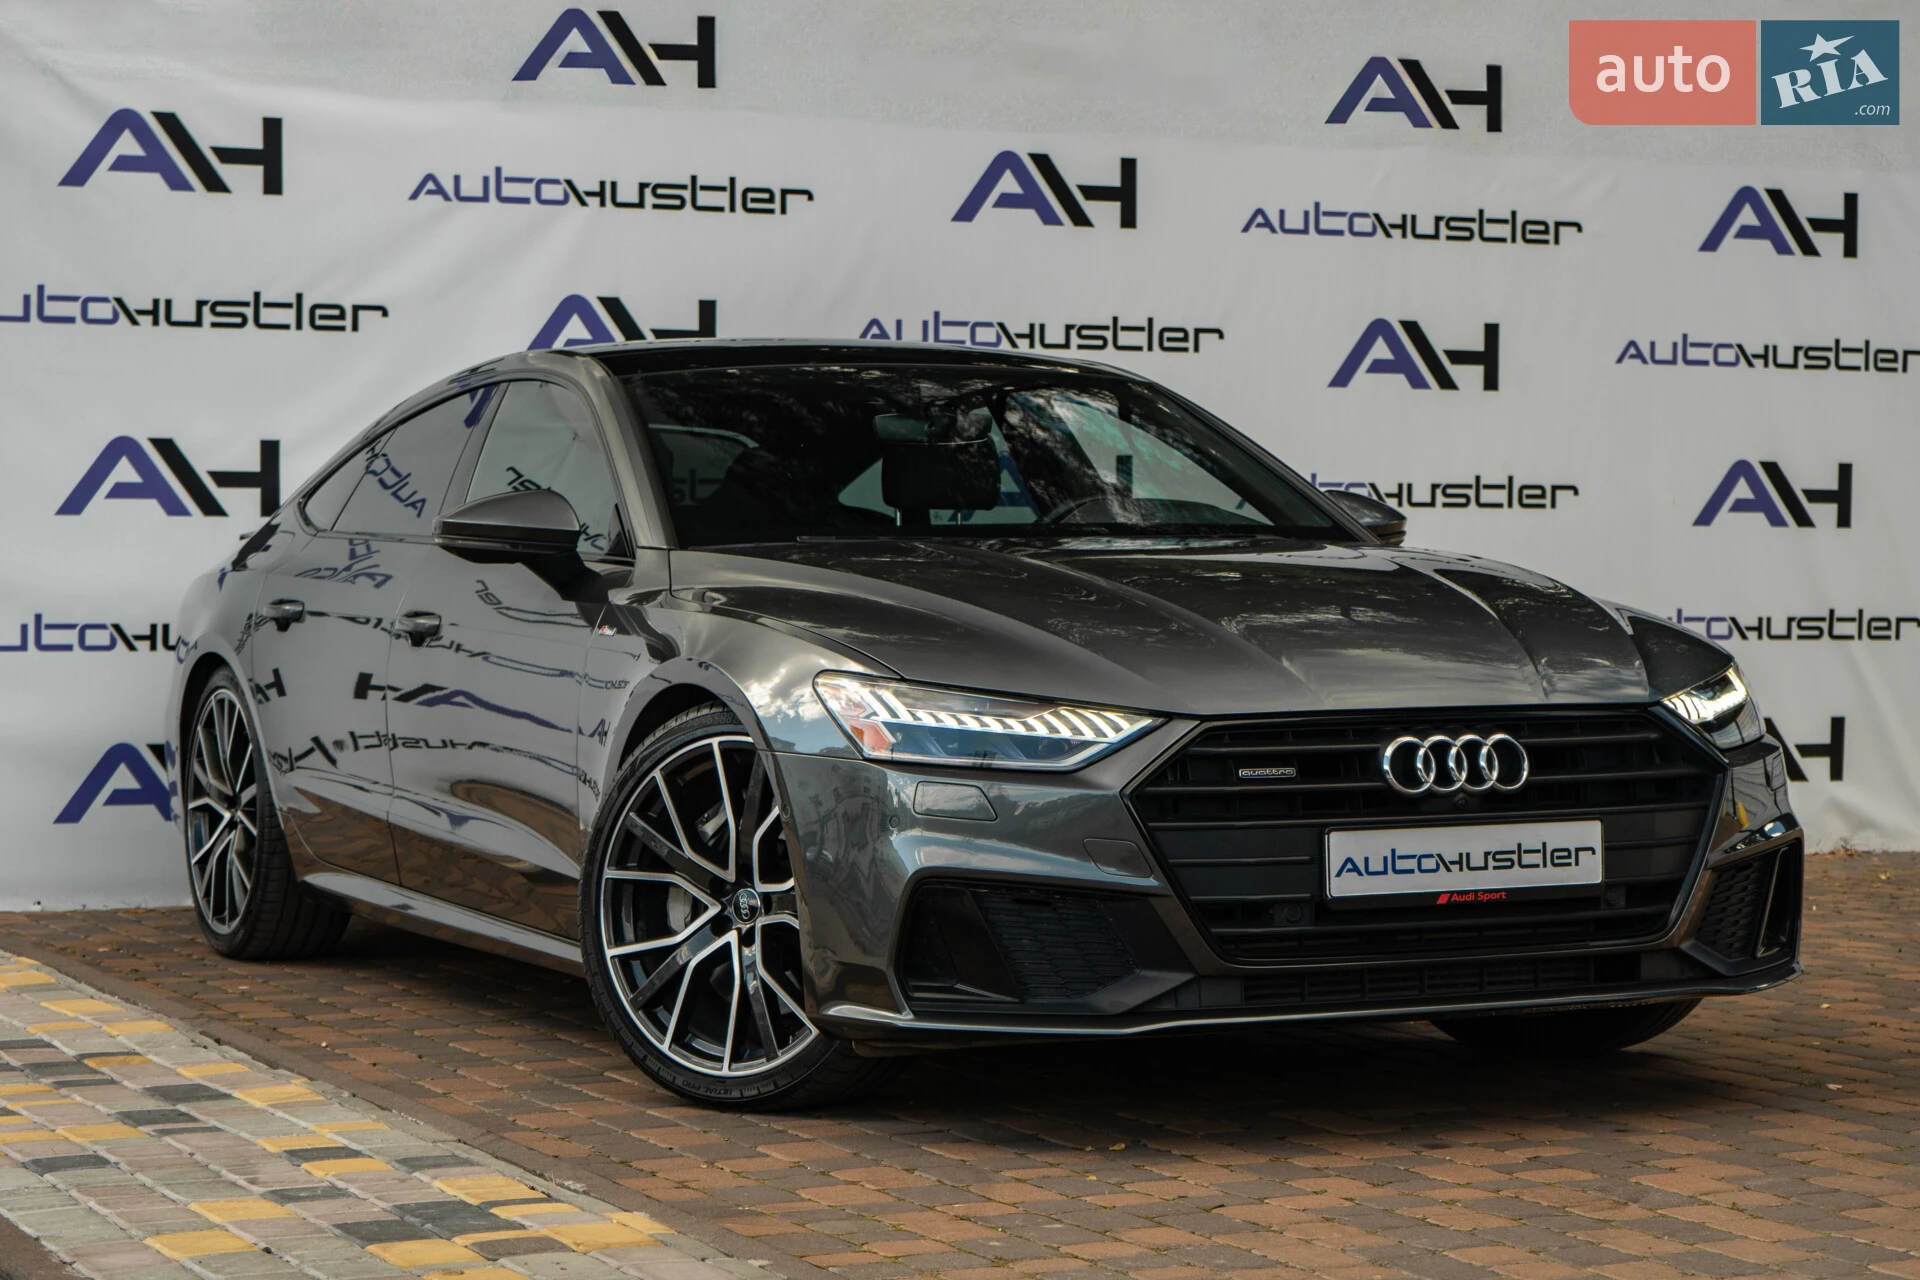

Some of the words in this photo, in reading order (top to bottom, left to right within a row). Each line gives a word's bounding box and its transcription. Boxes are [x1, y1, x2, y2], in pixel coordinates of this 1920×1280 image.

[512, 9, 716, 88] AH
[1325, 57, 1502, 132] AH
[58, 109, 283, 195] AH
[951, 151, 1137, 229] AH
[1699, 186, 1858, 259] AH
[1328, 318, 1499, 391] AH
[1692, 460, 1853, 528] AH
[1451, 891, 1475, 902] Audi
[1477, 890, 1507, 902] Sport
